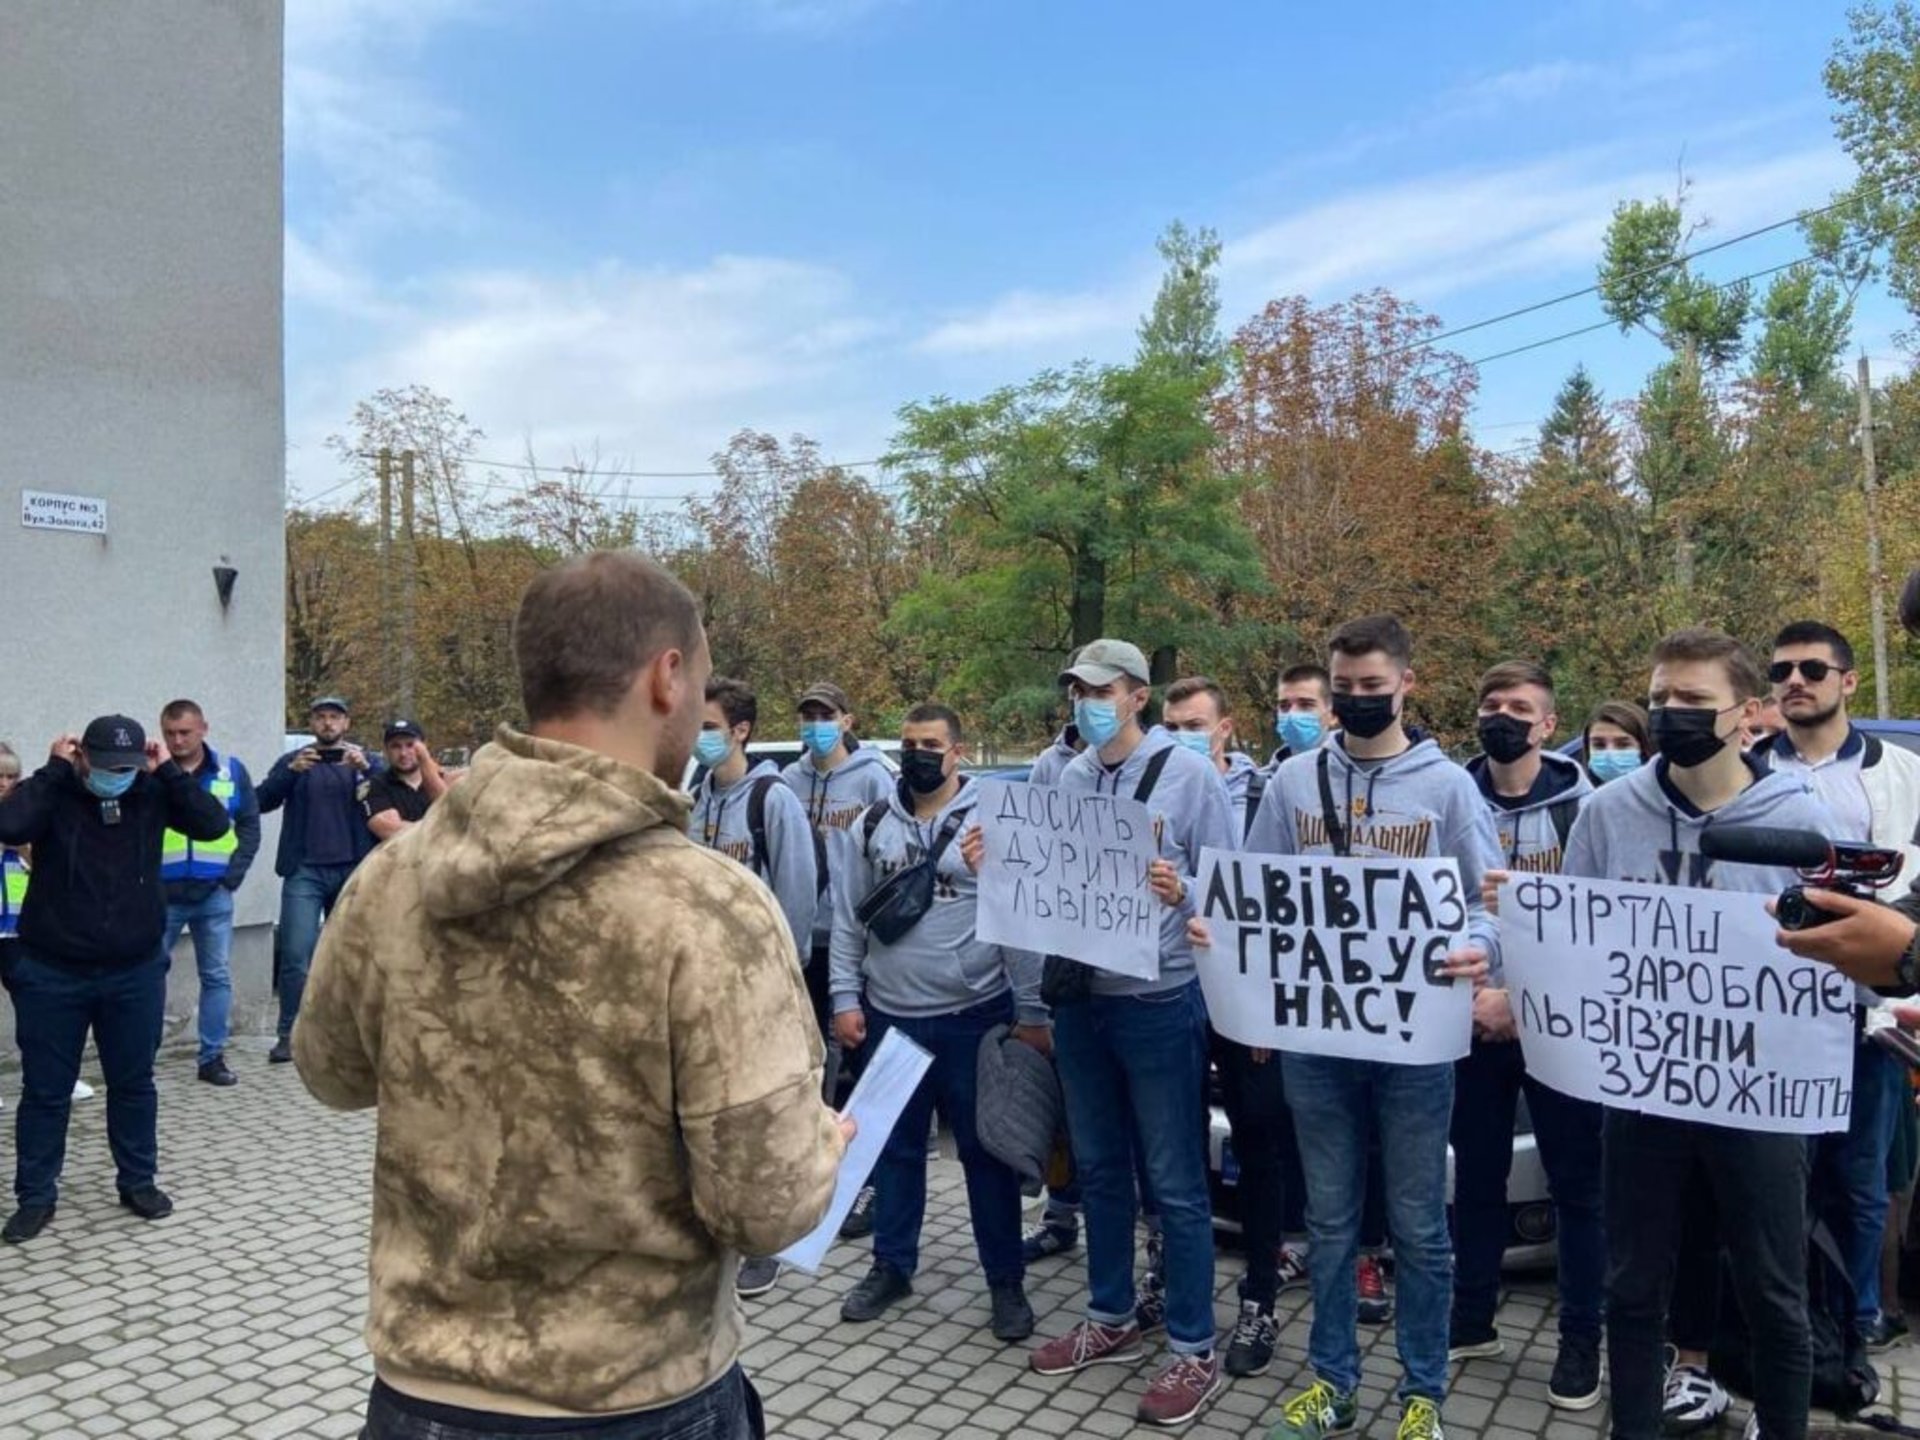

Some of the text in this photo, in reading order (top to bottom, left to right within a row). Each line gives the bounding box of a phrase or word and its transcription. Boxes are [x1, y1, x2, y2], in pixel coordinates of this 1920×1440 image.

[30, 498, 76, 512] КОРПУС
[996, 784, 1134, 841] ДОСИТЬ
[1002, 831, 1150, 889] ДУРИТИ
[1516, 877, 1722, 954] ФІРТАШ
[1238, 926, 1455, 987] ГРАБУЄ
[1274, 982, 1417, 1043] НАС!
[1598, 1048, 1853, 1120] ЗУБОЖІЮТЬ
